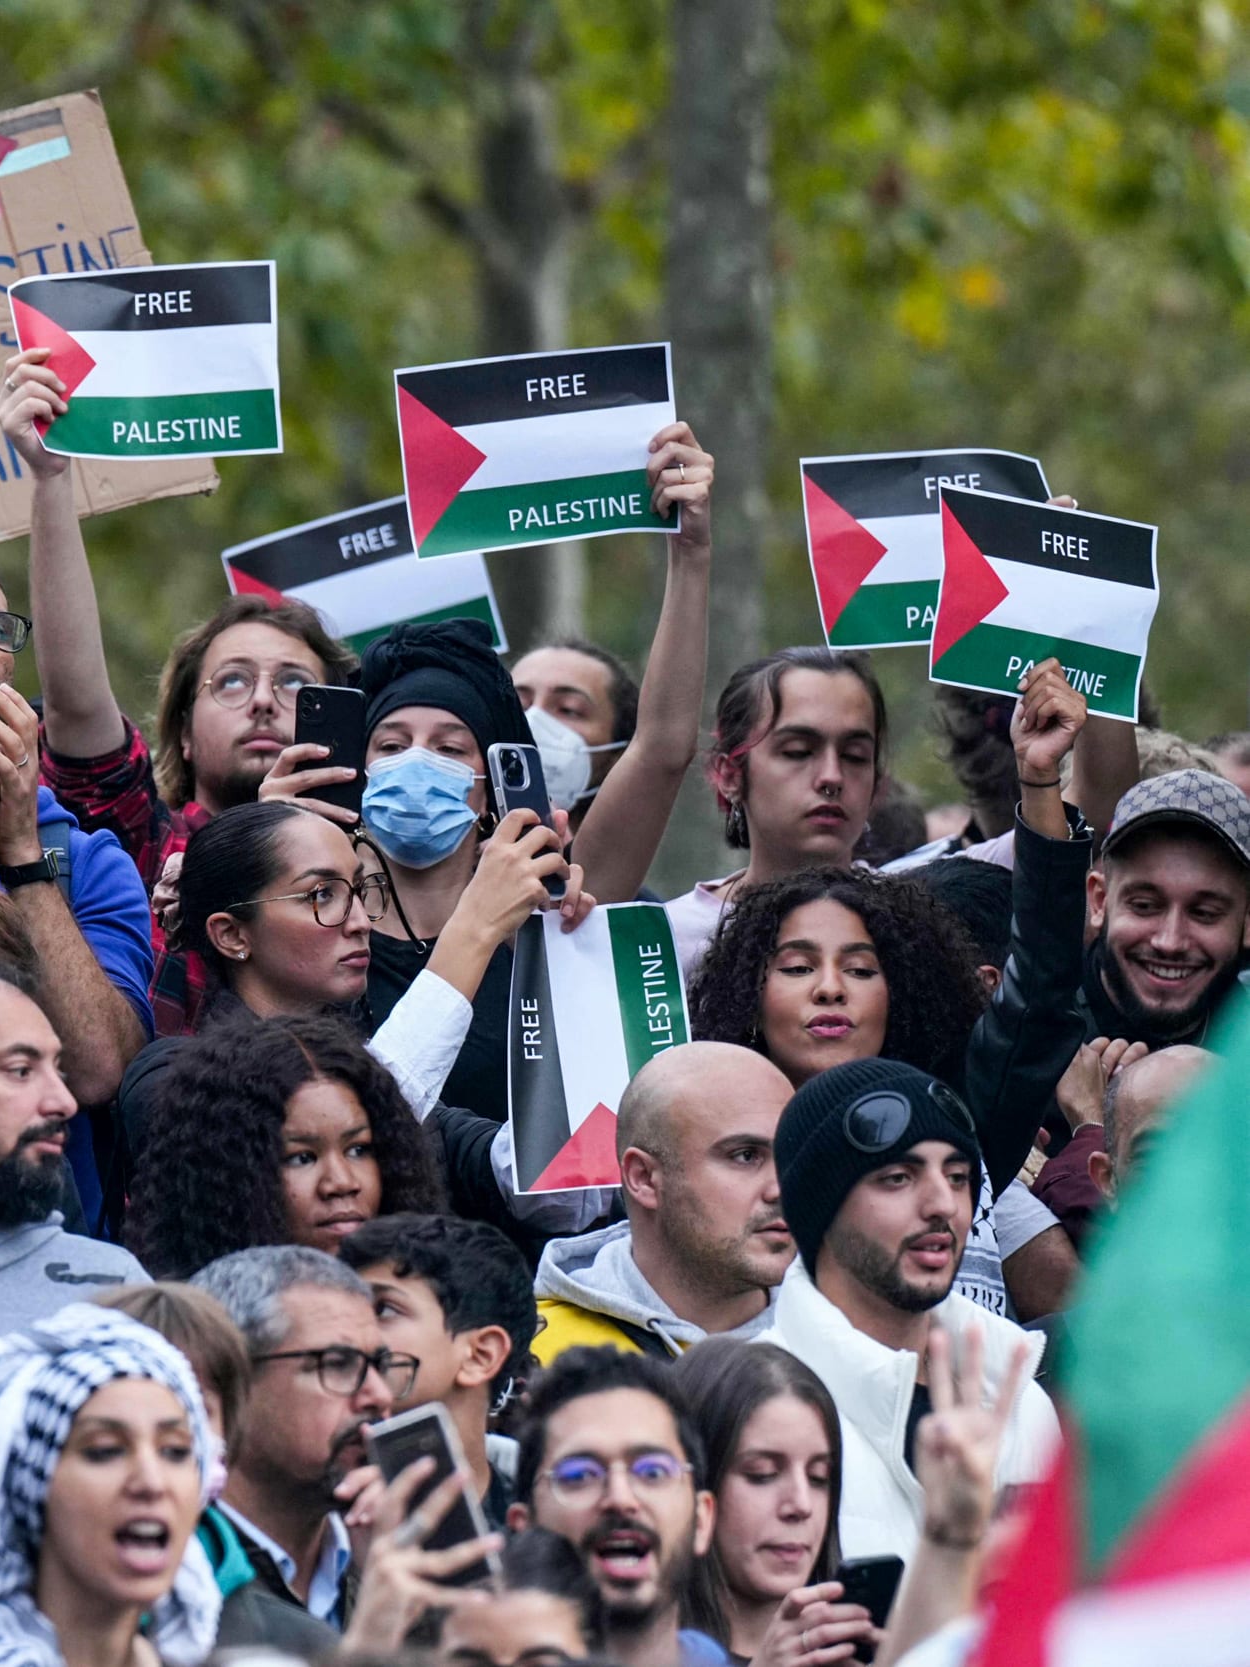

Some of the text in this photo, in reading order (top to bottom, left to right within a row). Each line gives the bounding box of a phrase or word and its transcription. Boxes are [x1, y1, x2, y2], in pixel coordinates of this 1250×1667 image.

[134, 291, 192, 315] FREE
[526, 373, 587, 401] FREE
[112, 416, 242, 444] PALESTINE
[508, 494, 642, 531] PALESTINE
[339, 523, 397, 559] FREE
[1040, 531, 1090, 561] FREE
[639, 942, 675, 1058] LESTINE
[524, 997, 544, 1060] FREE
